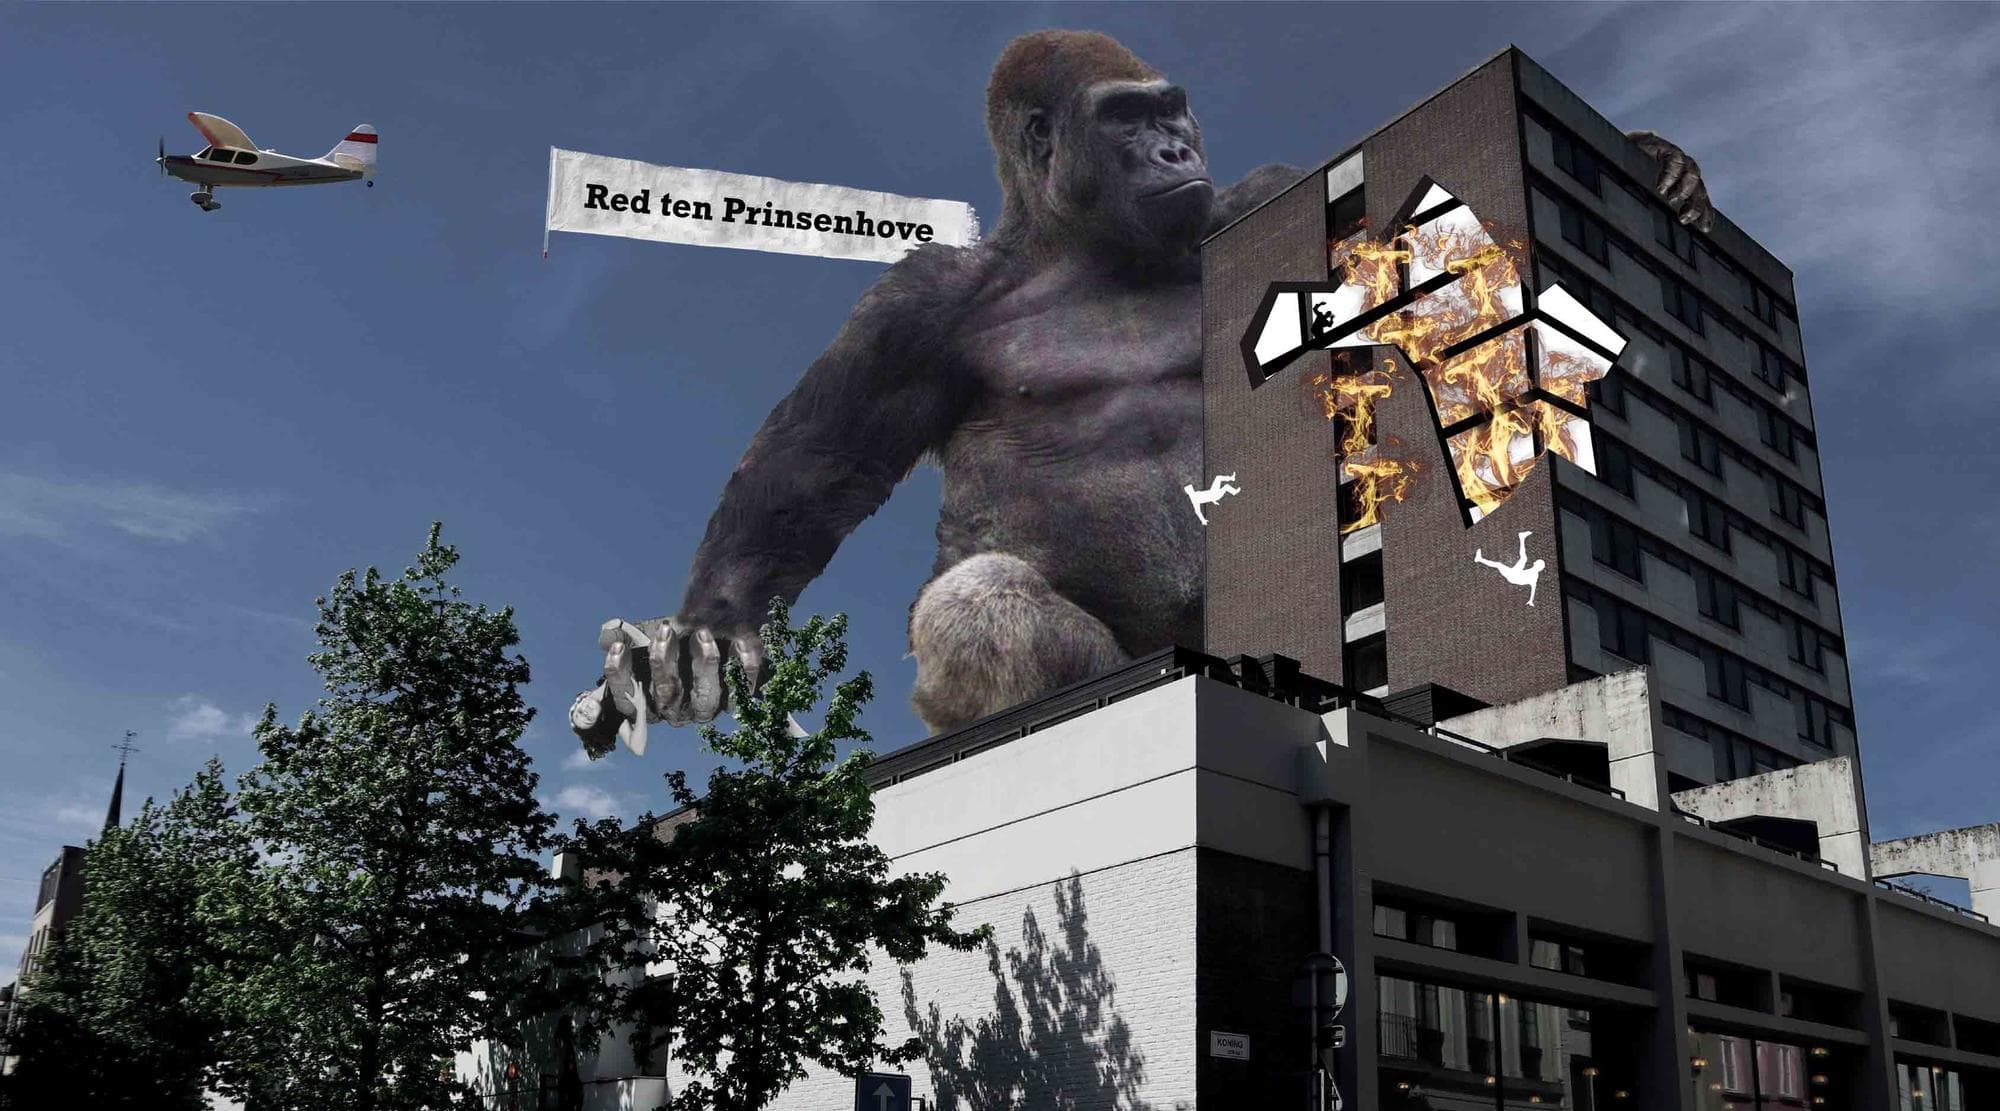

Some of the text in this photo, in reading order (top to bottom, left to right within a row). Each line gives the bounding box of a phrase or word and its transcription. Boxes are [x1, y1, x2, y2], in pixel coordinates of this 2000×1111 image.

[584, 183, 935, 243] Red ten Prinsenhove
[1216, 1038, 1244, 1049] KONING
